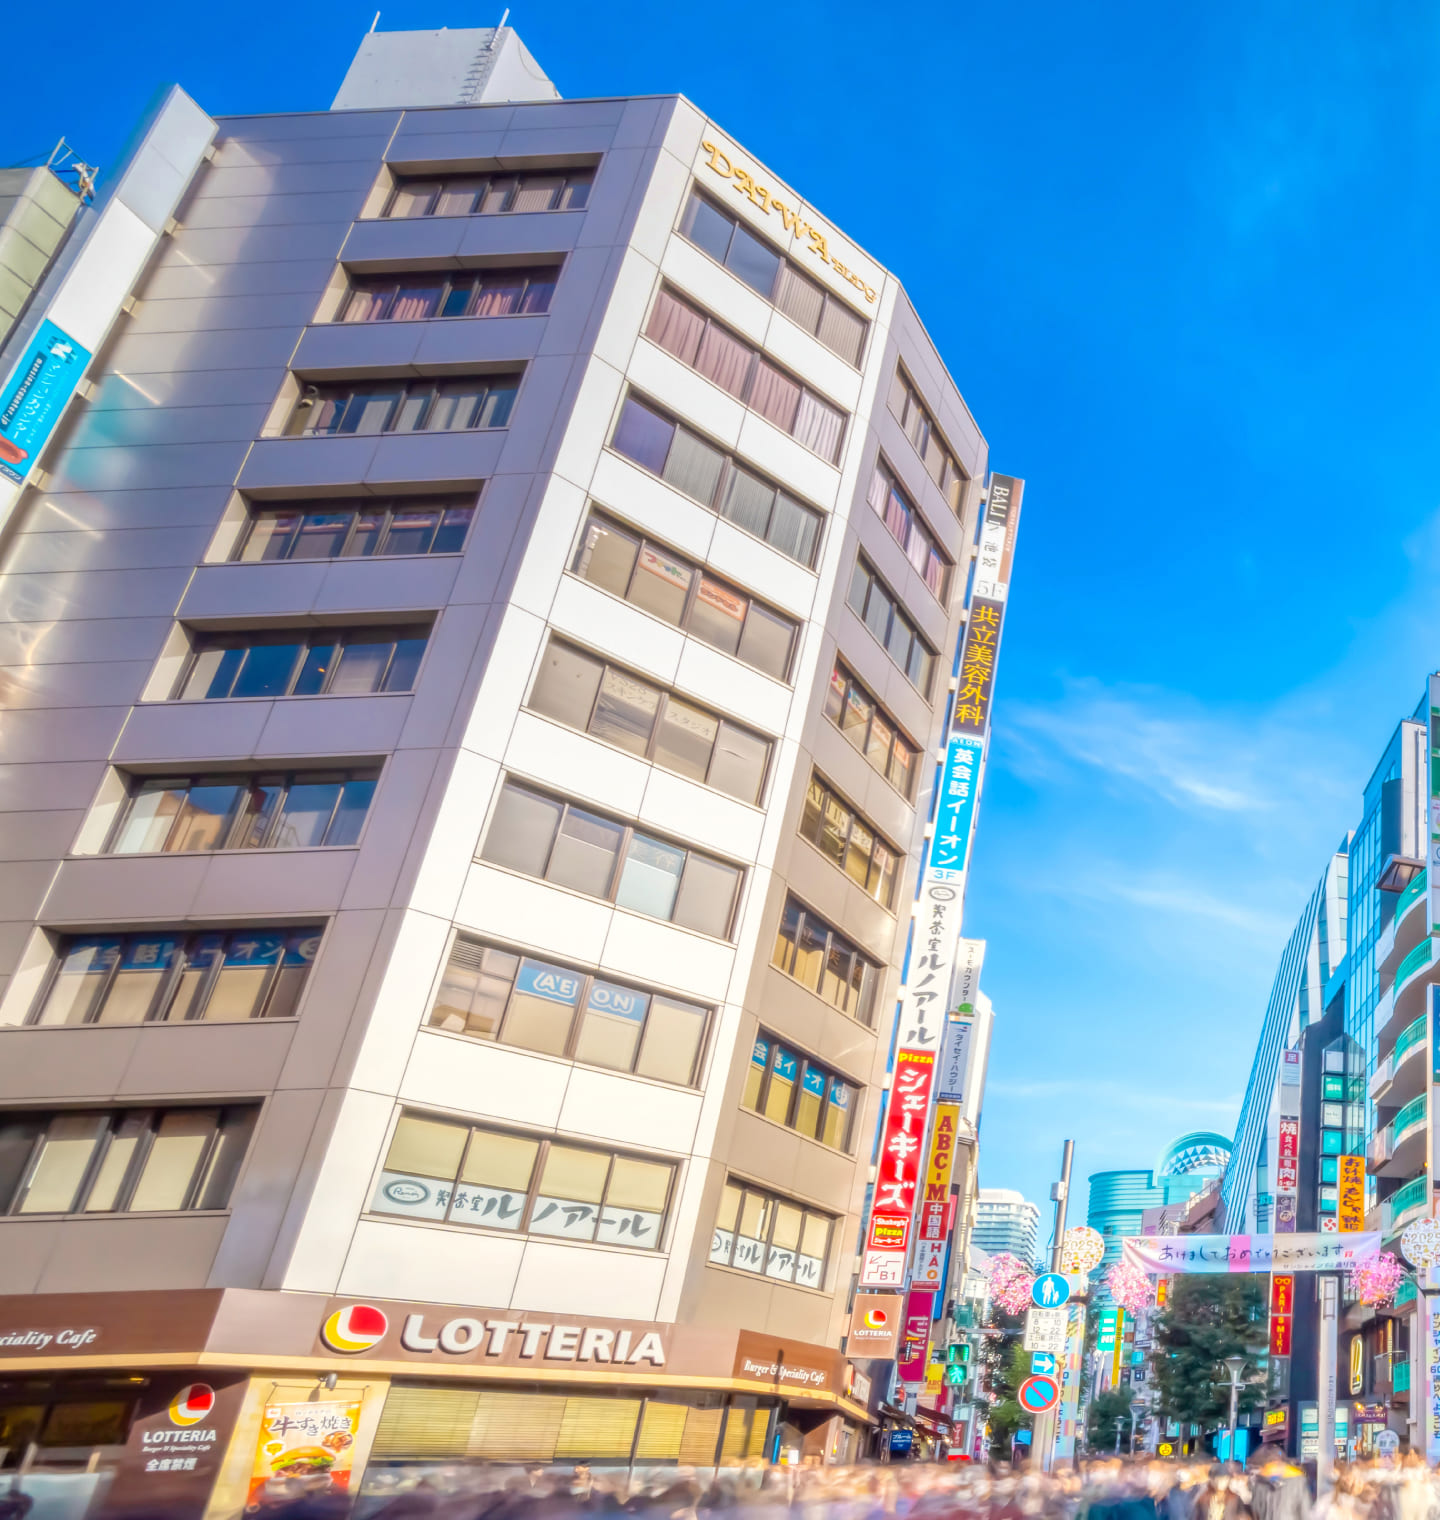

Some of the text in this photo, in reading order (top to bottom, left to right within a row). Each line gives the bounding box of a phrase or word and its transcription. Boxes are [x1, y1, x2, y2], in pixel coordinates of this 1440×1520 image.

[702, 140, 829, 264] DAIWA
[989, 485, 1010, 518] BALI
[955, 605, 1000, 726] 共立美容外科
[937, 747, 975, 865] 英会話イーオン
[933, 869, 956, 880] 3F
[907, 903, 947, 1044] 喫茶室ルノアール
[541, 972, 633, 1012] AEON
[876, 1068, 928, 1209] シェーキーズ
[926, 1202, 944, 1239] 中国語
[879, 1270, 896, 1281] B1
[1277, 1285, 1286, 1324] PARIS
[56, 1329, 97, 1349] Cafe
[400, 1313, 666, 1367] LOTTERIA
[853, 1329, 893, 1337] LOTTERIA
[1032, 1325, 1041, 1333] 12
[1050, 1326, 1061, 1335] 22
[1031, 1342, 1039, 1350] 10
[1047, 1342, 1059, 1350] 22
[744, 1359, 770, 1376] Burger
[143, 1429, 216, 1444] LOTTERIA
[269, 1415, 352, 1437] 牛すき焼き
[145, 1457, 198, 1472] 全席禁煙
